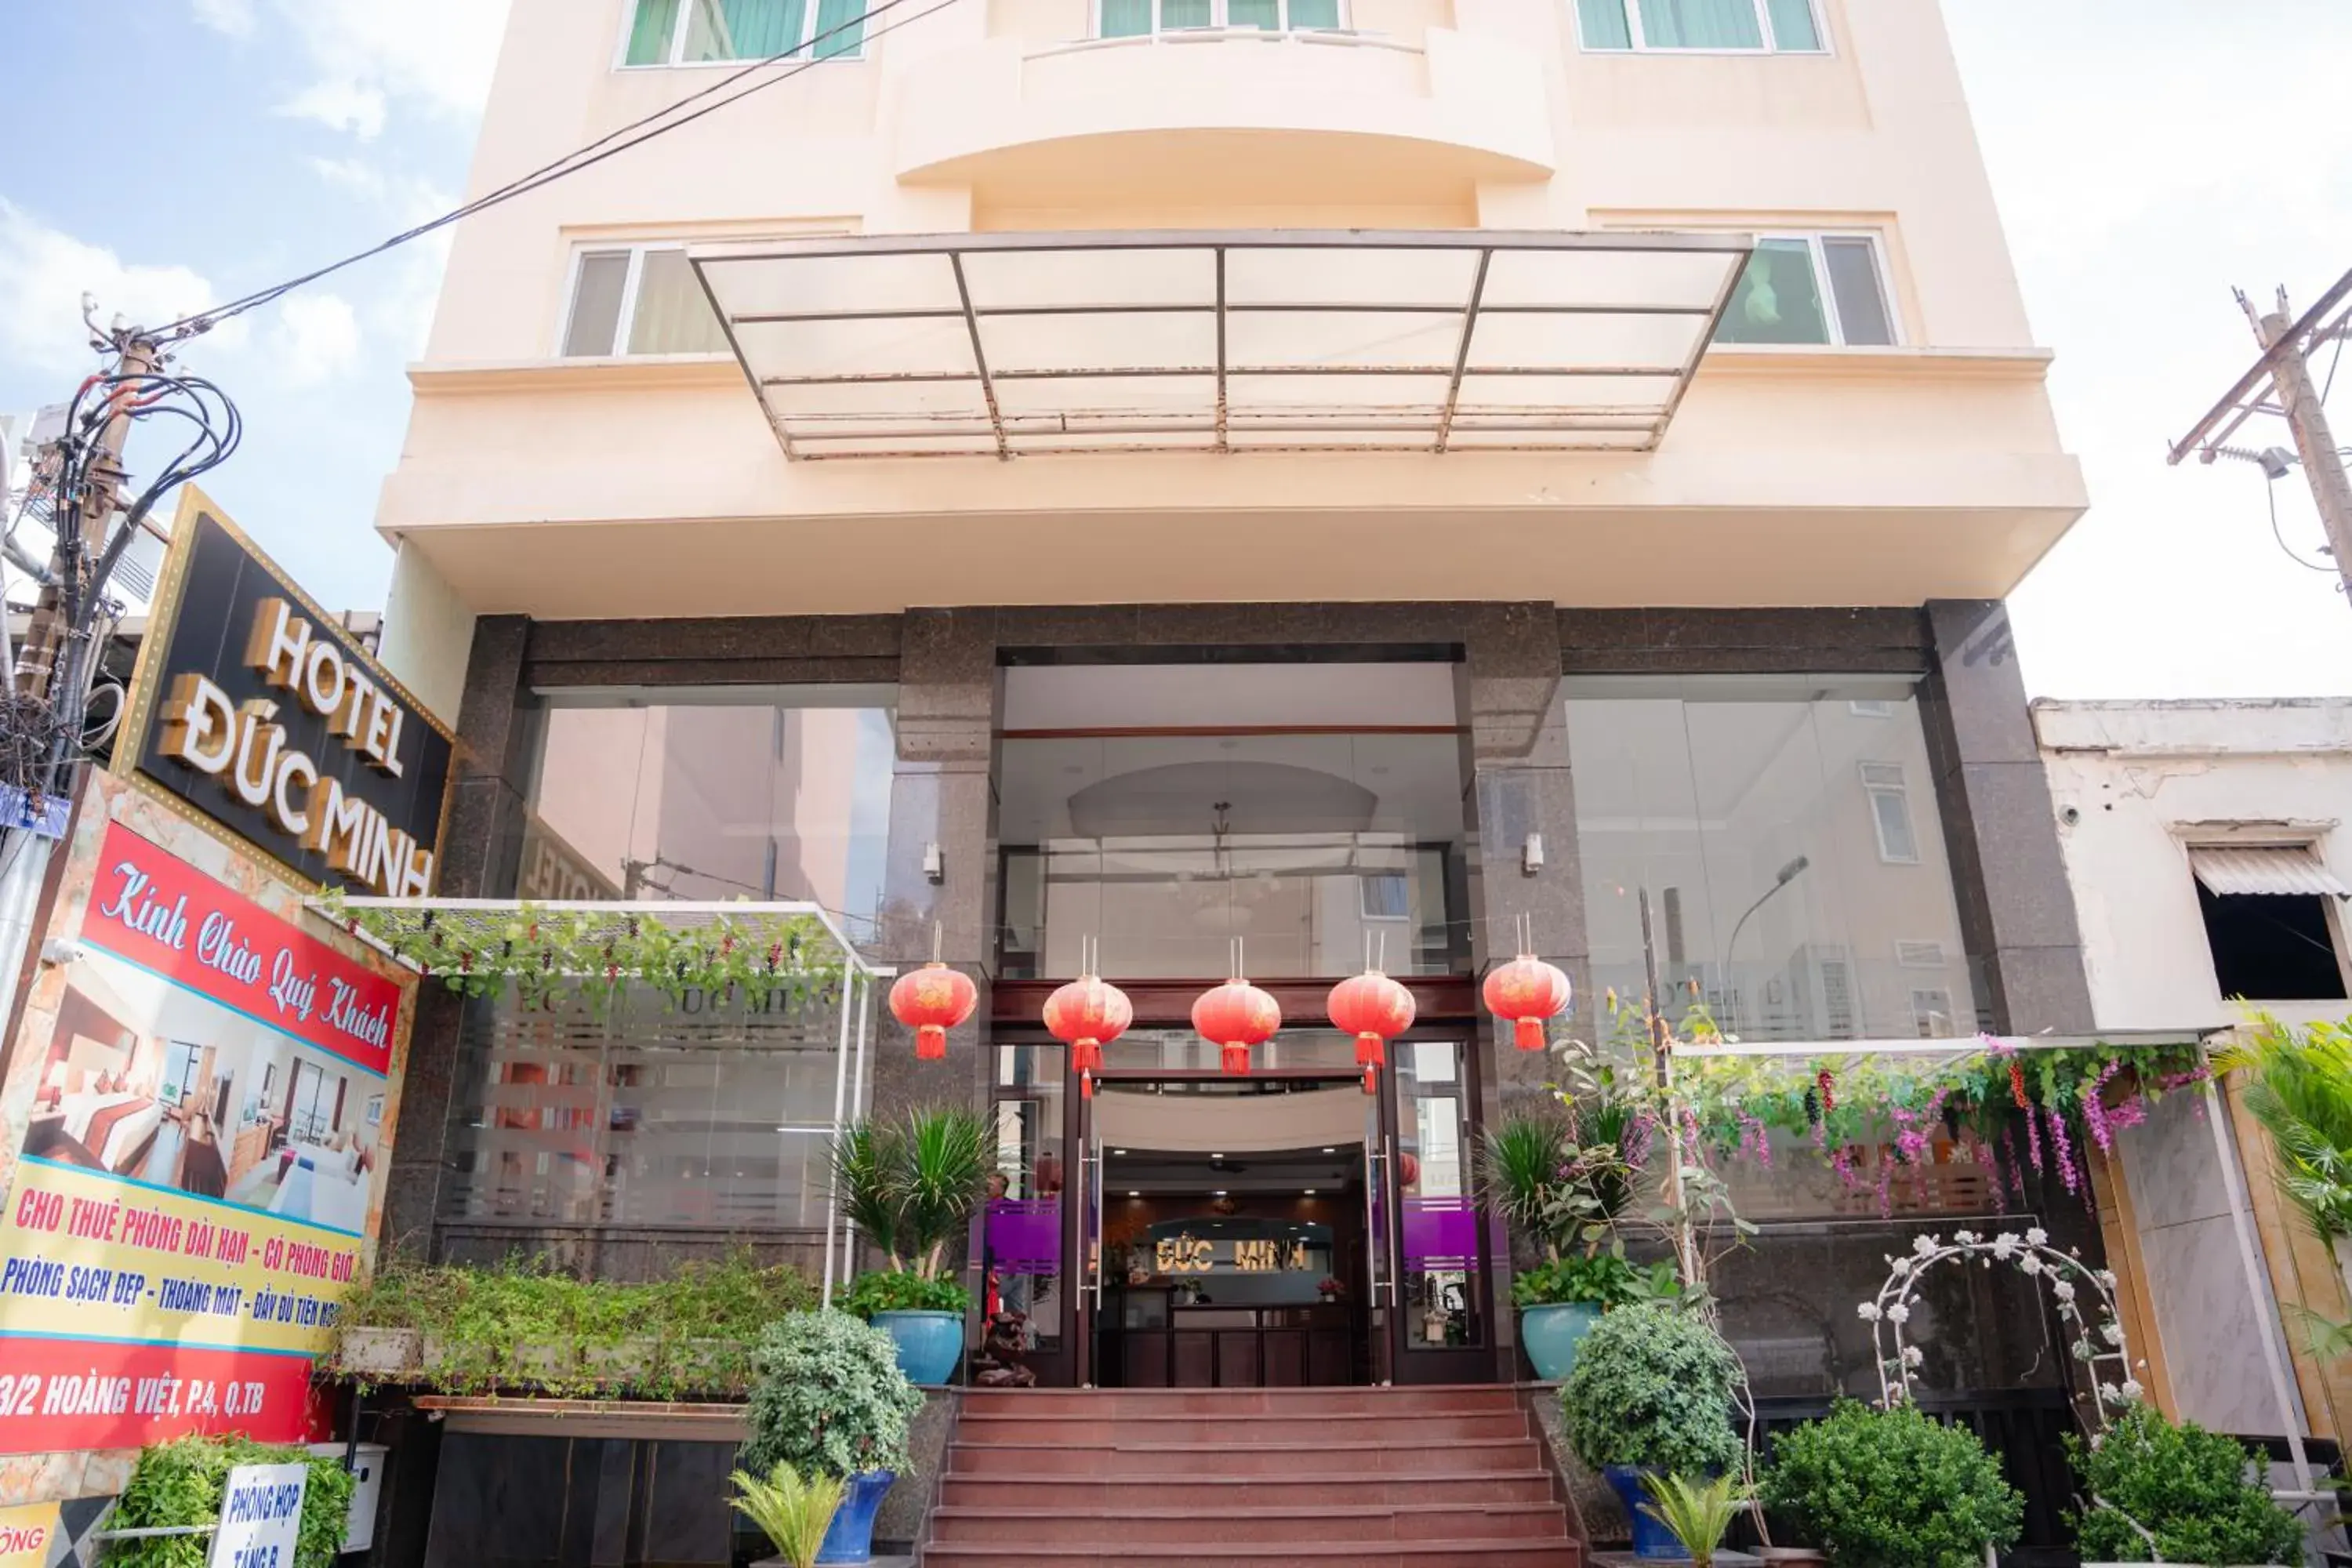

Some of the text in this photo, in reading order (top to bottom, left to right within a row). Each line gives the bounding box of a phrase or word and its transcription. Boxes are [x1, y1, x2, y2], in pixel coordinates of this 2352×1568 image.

[251, 597, 405, 779] HOTEL
[166, 676, 434, 897] ĐỨC MINH
[100, 861, 388, 1049] Kính Chào Quý Khách
[16, 1189, 64, 1232] CHO
[67, 1198, 120, 1241] THUÊ
[121, 1205, 183, 1252] PHÒNG
[184, 1217, 215, 1258] DÀI
[216, 1226, 249, 1270] HẠN
[263, 1233, 284, 1272] CÓ
[0, 1254, 65, 1298] PHÒNG
[66, 1265, 112, 1307] SẠCH
[113, 1271, 144, 1312] ĐẸP
[159, 1276, 212, 1315] THOÁNG
[212, 1283, 241, 1316] MÁT
[42, 1367, 131, 1415] HOÀNG
[133, 1371, 182, 1421] VIỆT,
[224, 1381, 265, 1417] Q.TB
[228, 1476, 299, 1529] PHÒNG HỌP
